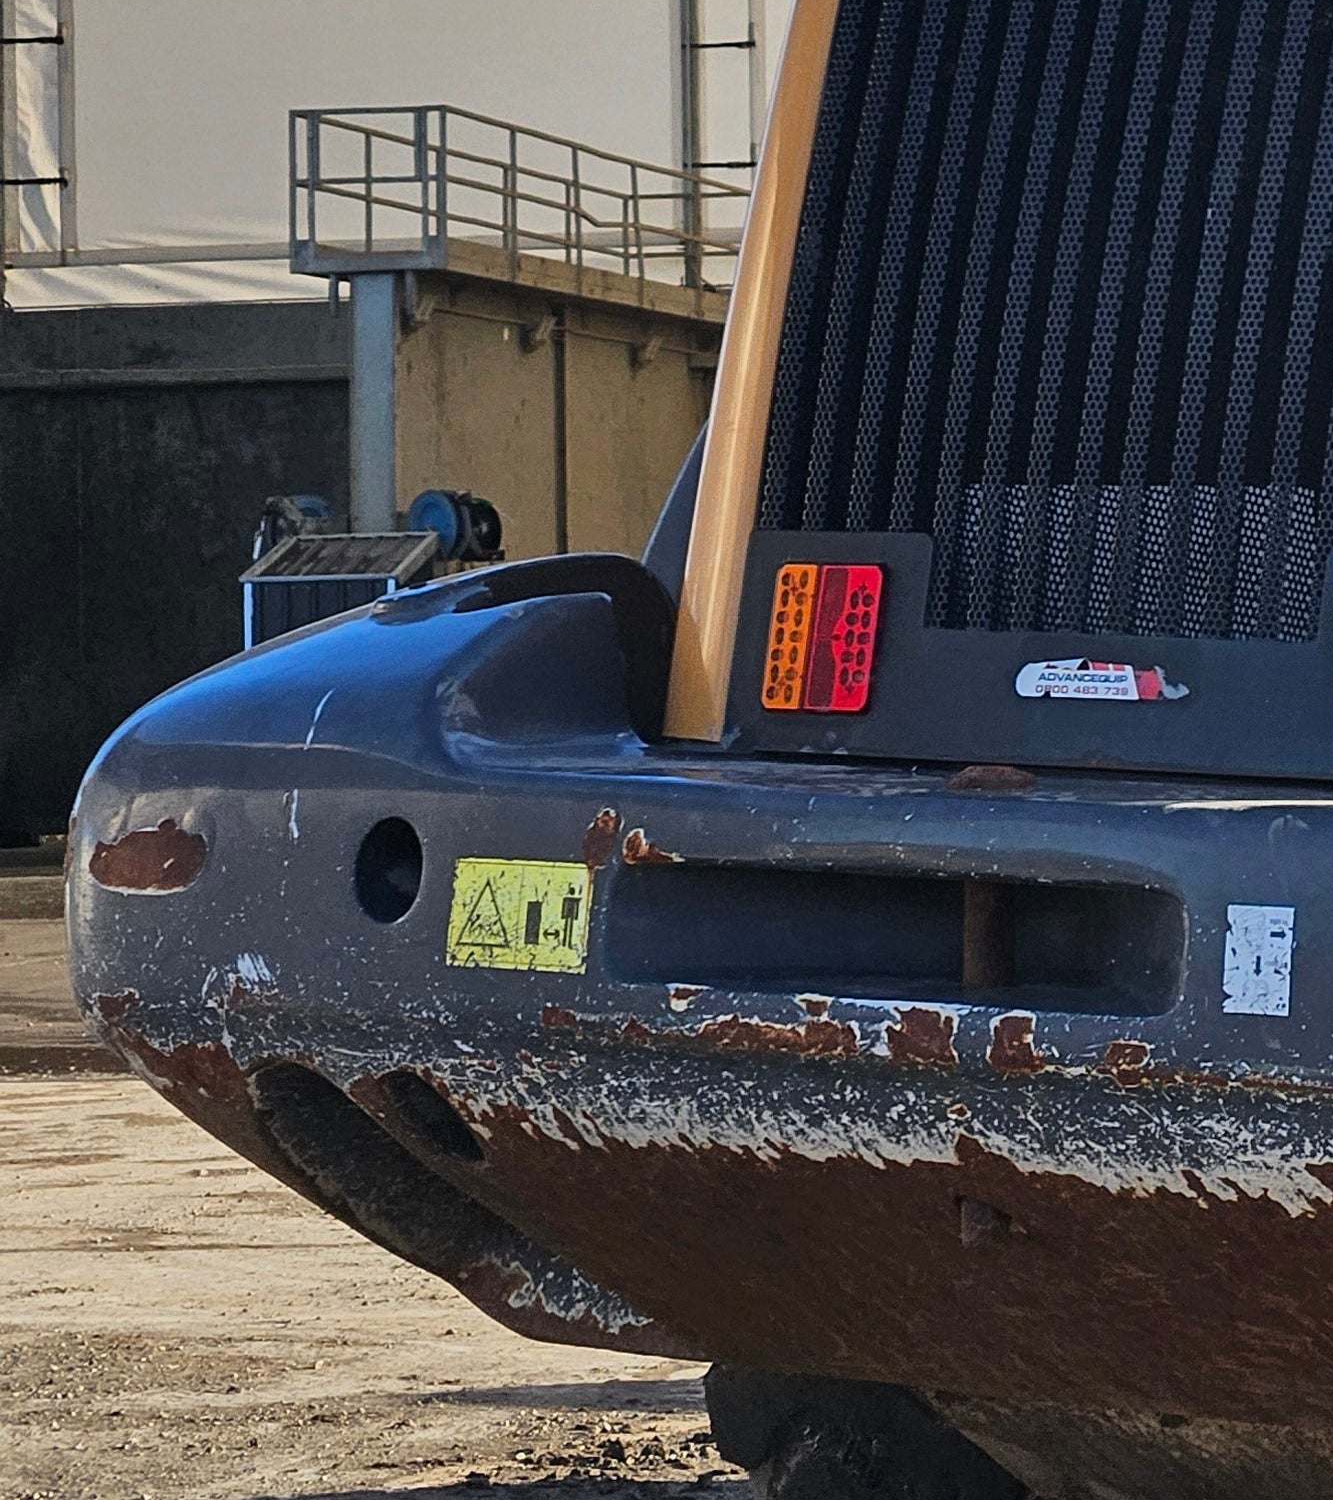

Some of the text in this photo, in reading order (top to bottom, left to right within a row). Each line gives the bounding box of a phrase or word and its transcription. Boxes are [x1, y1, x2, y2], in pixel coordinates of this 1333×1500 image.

[1037, 671, 1129, 684] ADVANCEQUIP
[1035, 684, 1129, 696] 0800 483 739
